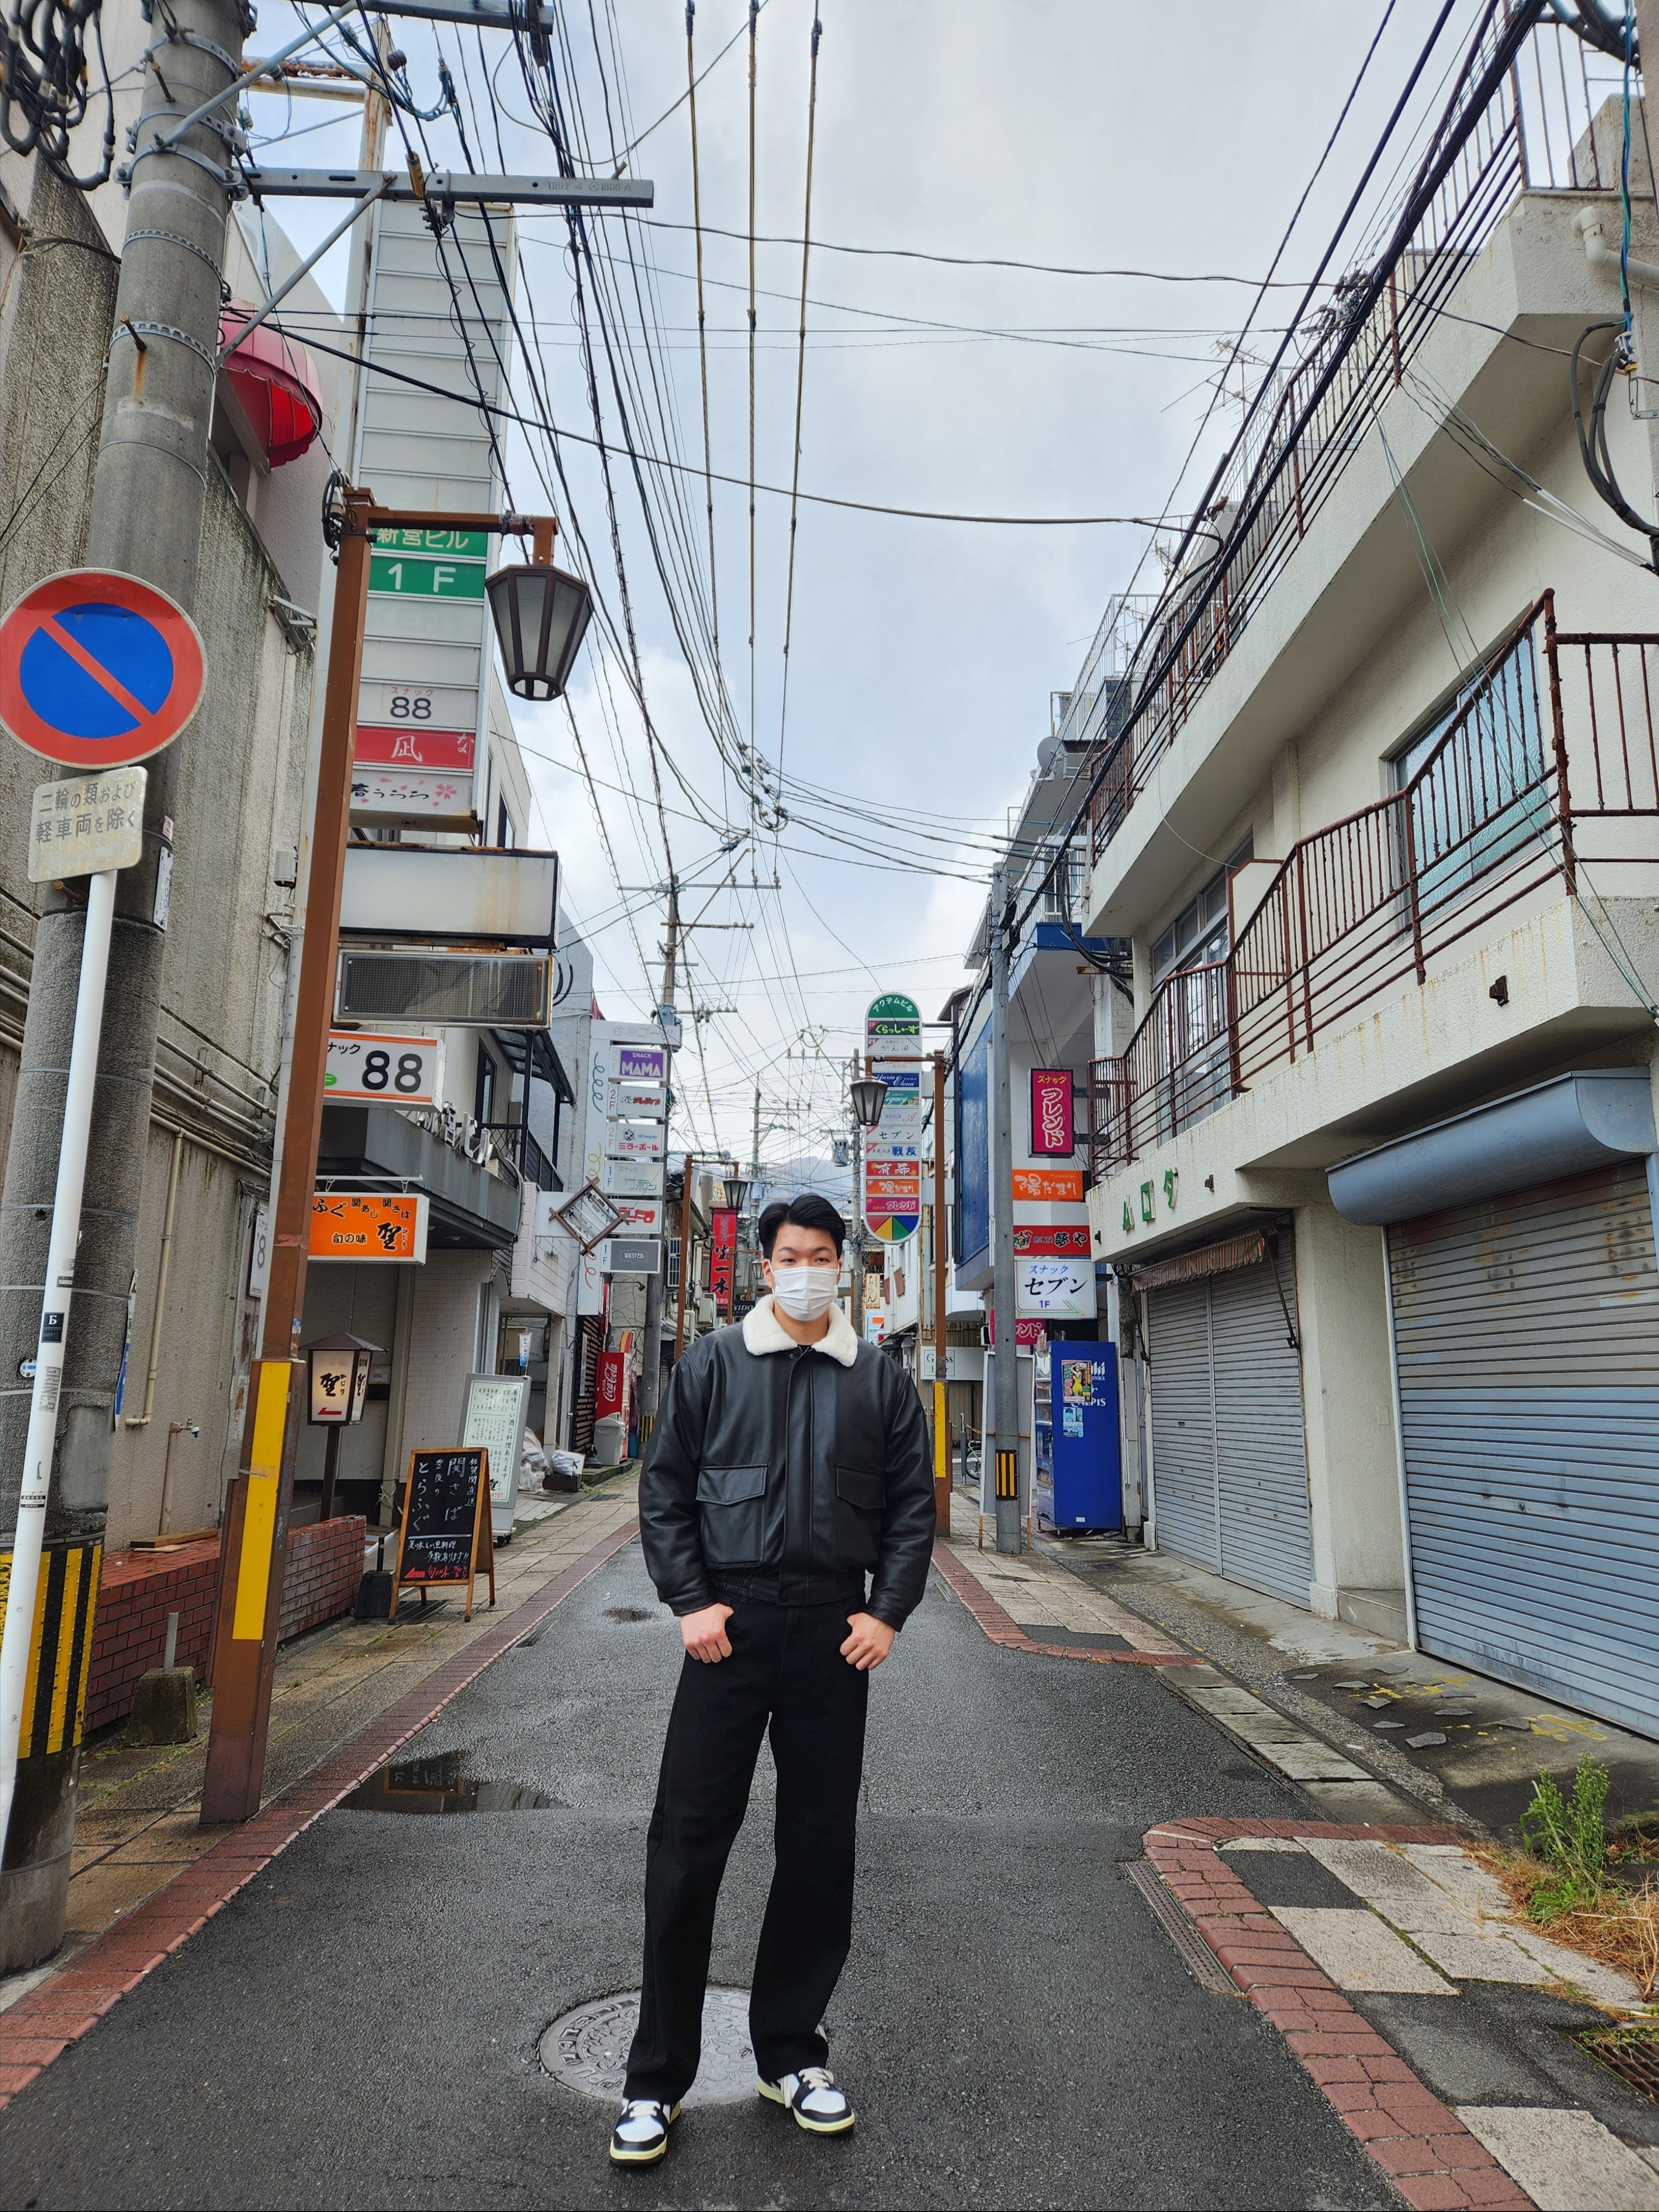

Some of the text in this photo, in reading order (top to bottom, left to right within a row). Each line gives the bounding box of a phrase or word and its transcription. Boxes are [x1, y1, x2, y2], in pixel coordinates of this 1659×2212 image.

[377, 528, 469, 549] 新宮ビル
[390, 686, 433, 697] スナック
[390, 696, 431, 719] 88
[390, 735, 422, 763] 凪
[39, 780, 137, 812] 二輪の類および
[36, 806, 135, 844] 軽車両を除く
[873, 997, 913, 1013] アクテムビル
[613, 1025, 674, 1038] 佐治コー
[362, 1050, 422, 1093] 88
[622, 1061, 661, 1077] MAMA
[1037, 1075, 1067, 1084] スナック
[1041, 1088, 1065, 1148] フレンド
[609, 1127, 614, 1147] 2F
[879, 1131, 914, 1139] セブン
[619, 1142, 659, 1151] ミラーボール
[891, 1145, 917, 1156] 戦友
[607, 1166, 612, 1186] 1F
[875, 1162, 910, 1176] 有希
[1014, 1173, 1077, 1196] 陽だまり
[312, 1198, 411, 1219] ふぐ 関あじ 関さば
[886, 1201, 916, 1211] フレンド
[1122, 1166, 1178, 1232] ムロタ
[332, 1233, 367, 1244] 旬の味
[377, 1221, 402, 1251] 聖
[1054, 1232, 1088, 1248] 夢や
[603, 1244, 607, 1265] 1F
[712, 1244, 729, 1296] 生一本
[1028, 1265, 1068, 1275] スナック
[1024, 1277, 1088, 1295] セブン
[1039, 1300, 1050, 1308] 1F
[1016, 1322, 1042, 1339] ンド
[926, 1353, 953, 1363] Gss
[320, 1372, 341, 1397] 聖
[603, 1360, 618, 1402] Coca-Cola
[501, 1388, 518, 1480] 美味しい酒と料理あります
[434, 1459, 444, 1496] 豊後の
[465, 1457, 478, 1507] 佐賀関直送
[411, 1462, 430, 1532] とらふぐ
[445, 1457, 466, 1521] 関さば
[407, 1539, 457, 1551] 美味しい魚料理
[427, 1564, 462, 1579] 旬の味 聖
